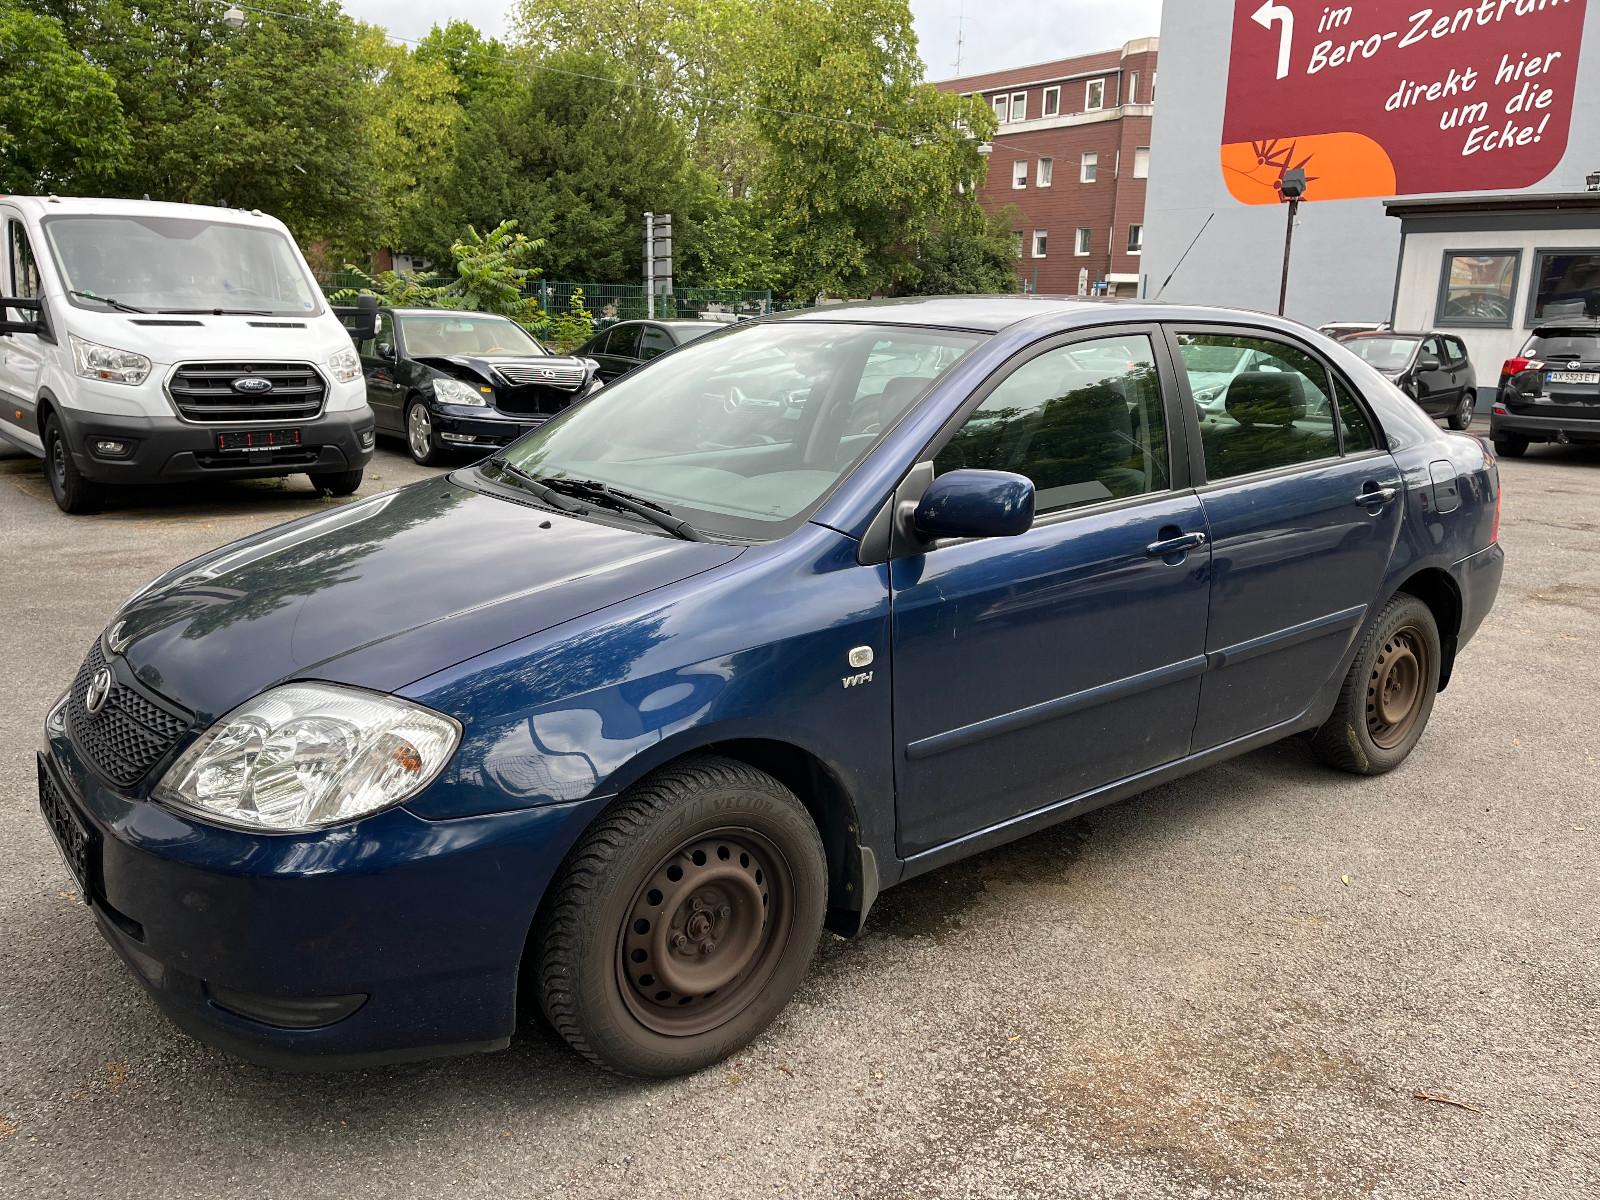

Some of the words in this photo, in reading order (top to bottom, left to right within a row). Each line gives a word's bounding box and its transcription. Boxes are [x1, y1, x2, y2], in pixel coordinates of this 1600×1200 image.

[1317, 6, 1354, 33] im
[1384, 66, 1478, 112] direkt
[1494, 51, 1562, 86] hier
[1439, 101, 1489, 131] um
[1504, 81, 1553, 115] die
[1461, 113, 1551, 156] Ecke!
